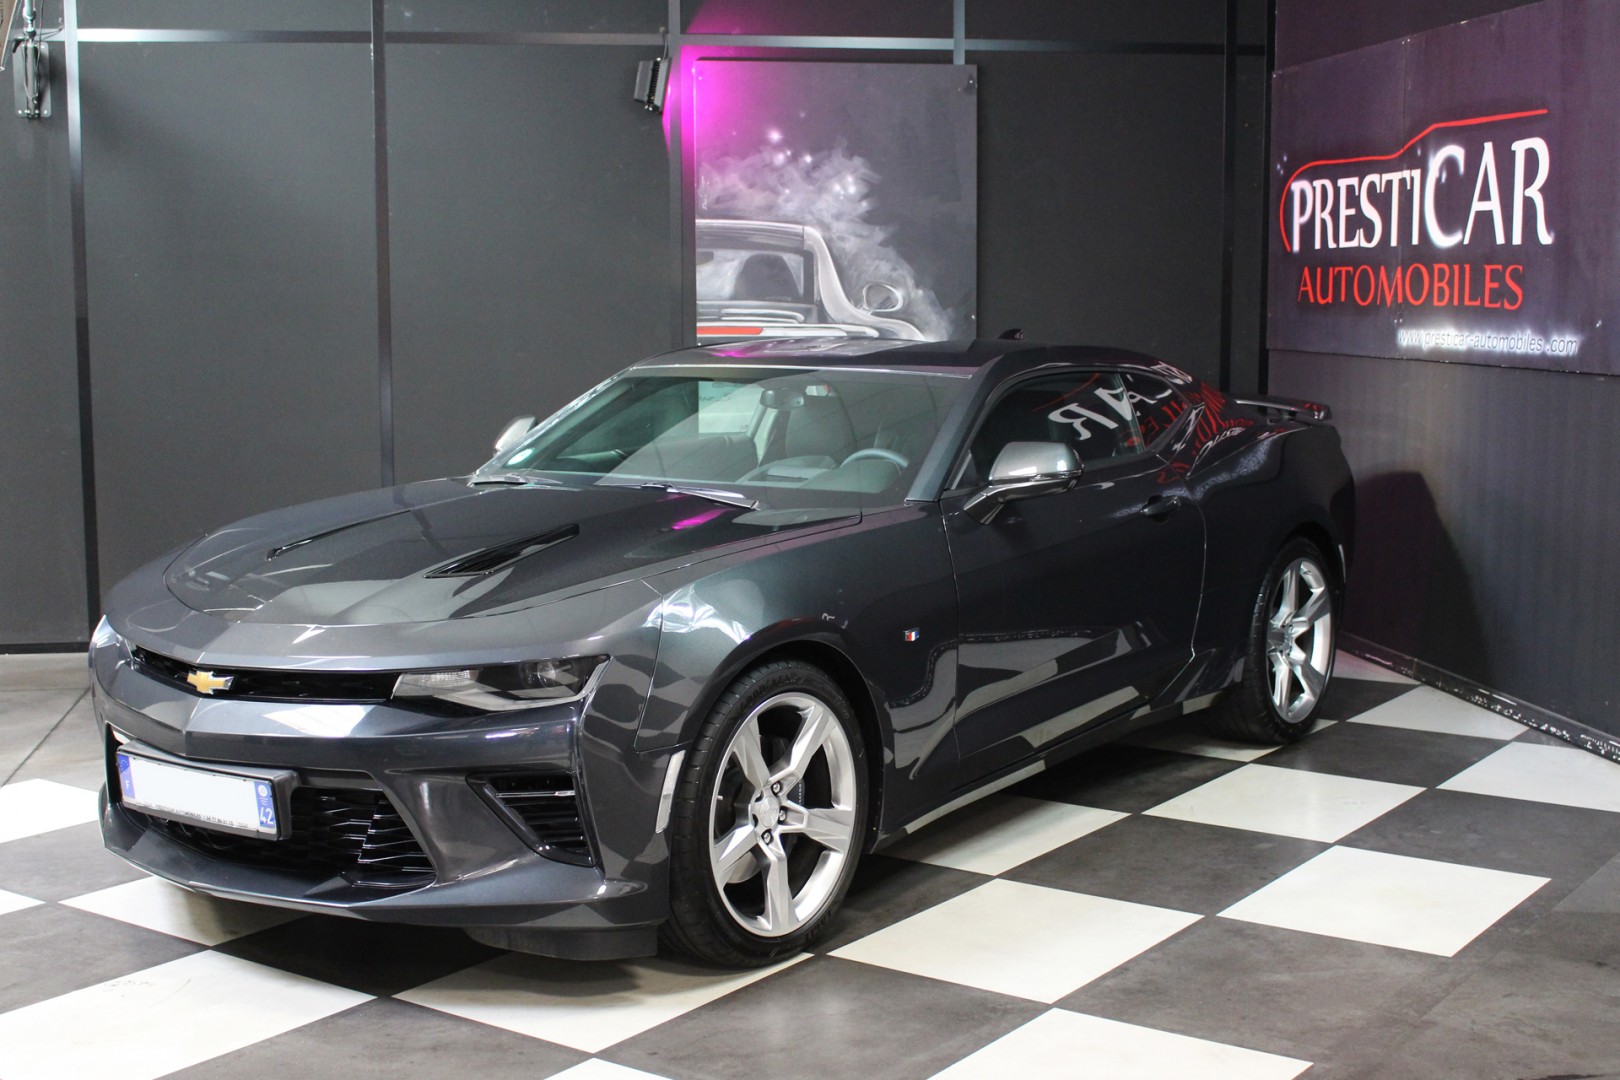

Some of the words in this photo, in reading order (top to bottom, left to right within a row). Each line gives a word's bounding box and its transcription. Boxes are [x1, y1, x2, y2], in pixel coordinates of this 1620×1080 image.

[1291, 137, 1554, 252] PRESTICAR
[1298, 263, 1524, 310] AUTOMOBILES
[1398, 330, 1578, 354] wwwpresticar-automobiles.com
[260, 807, 274, 825] 42
